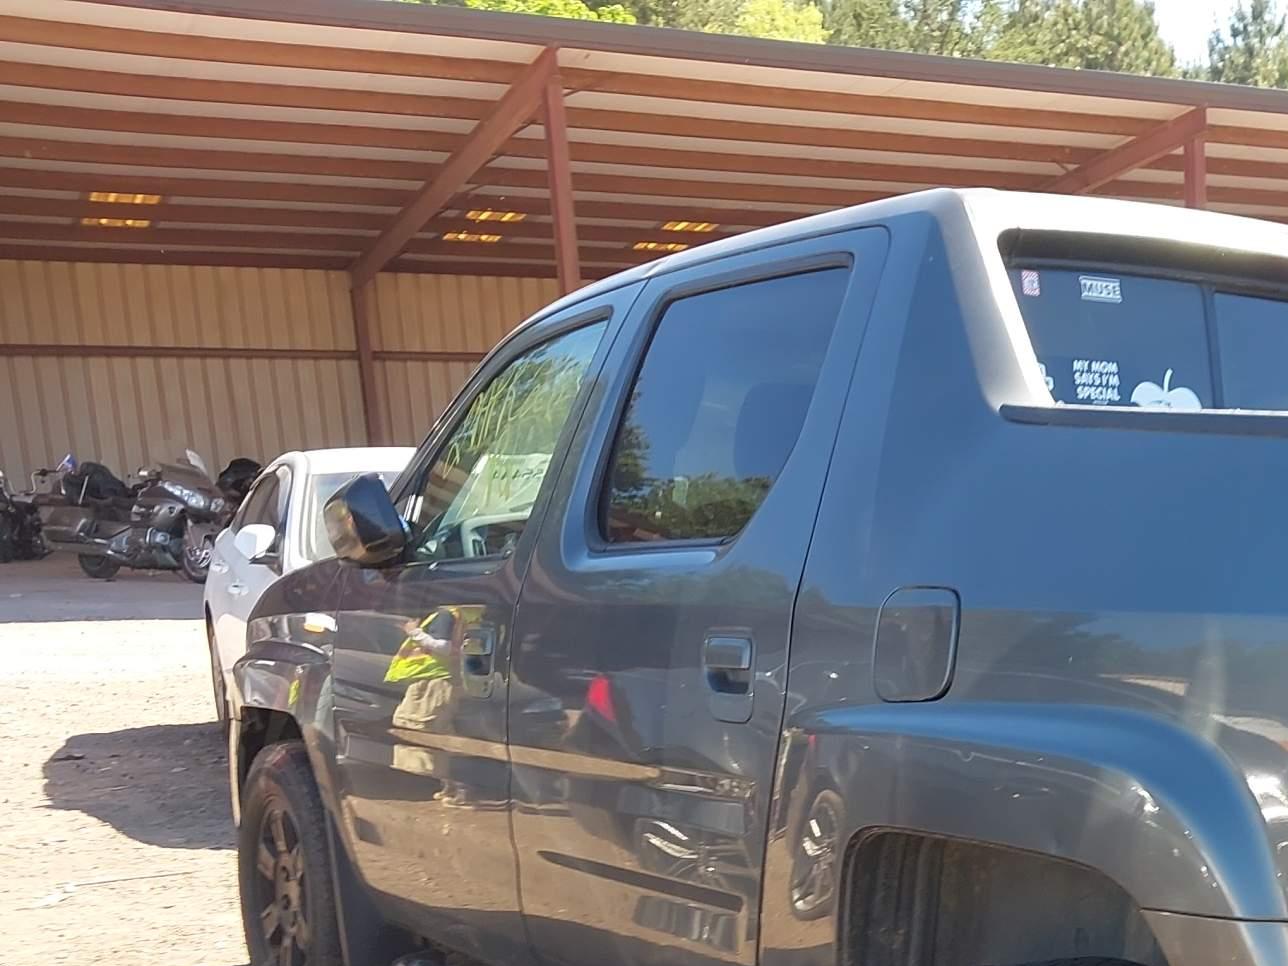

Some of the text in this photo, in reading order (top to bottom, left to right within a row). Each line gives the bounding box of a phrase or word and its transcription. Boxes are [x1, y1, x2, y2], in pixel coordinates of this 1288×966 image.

[1081, 279, 1121, 298] MUSE
[1073, 360, 1119, 374] MY MOM
[1074, 371, 1101, 385] SAYS
[1077, 385, 1121, 401] SPECIAL
